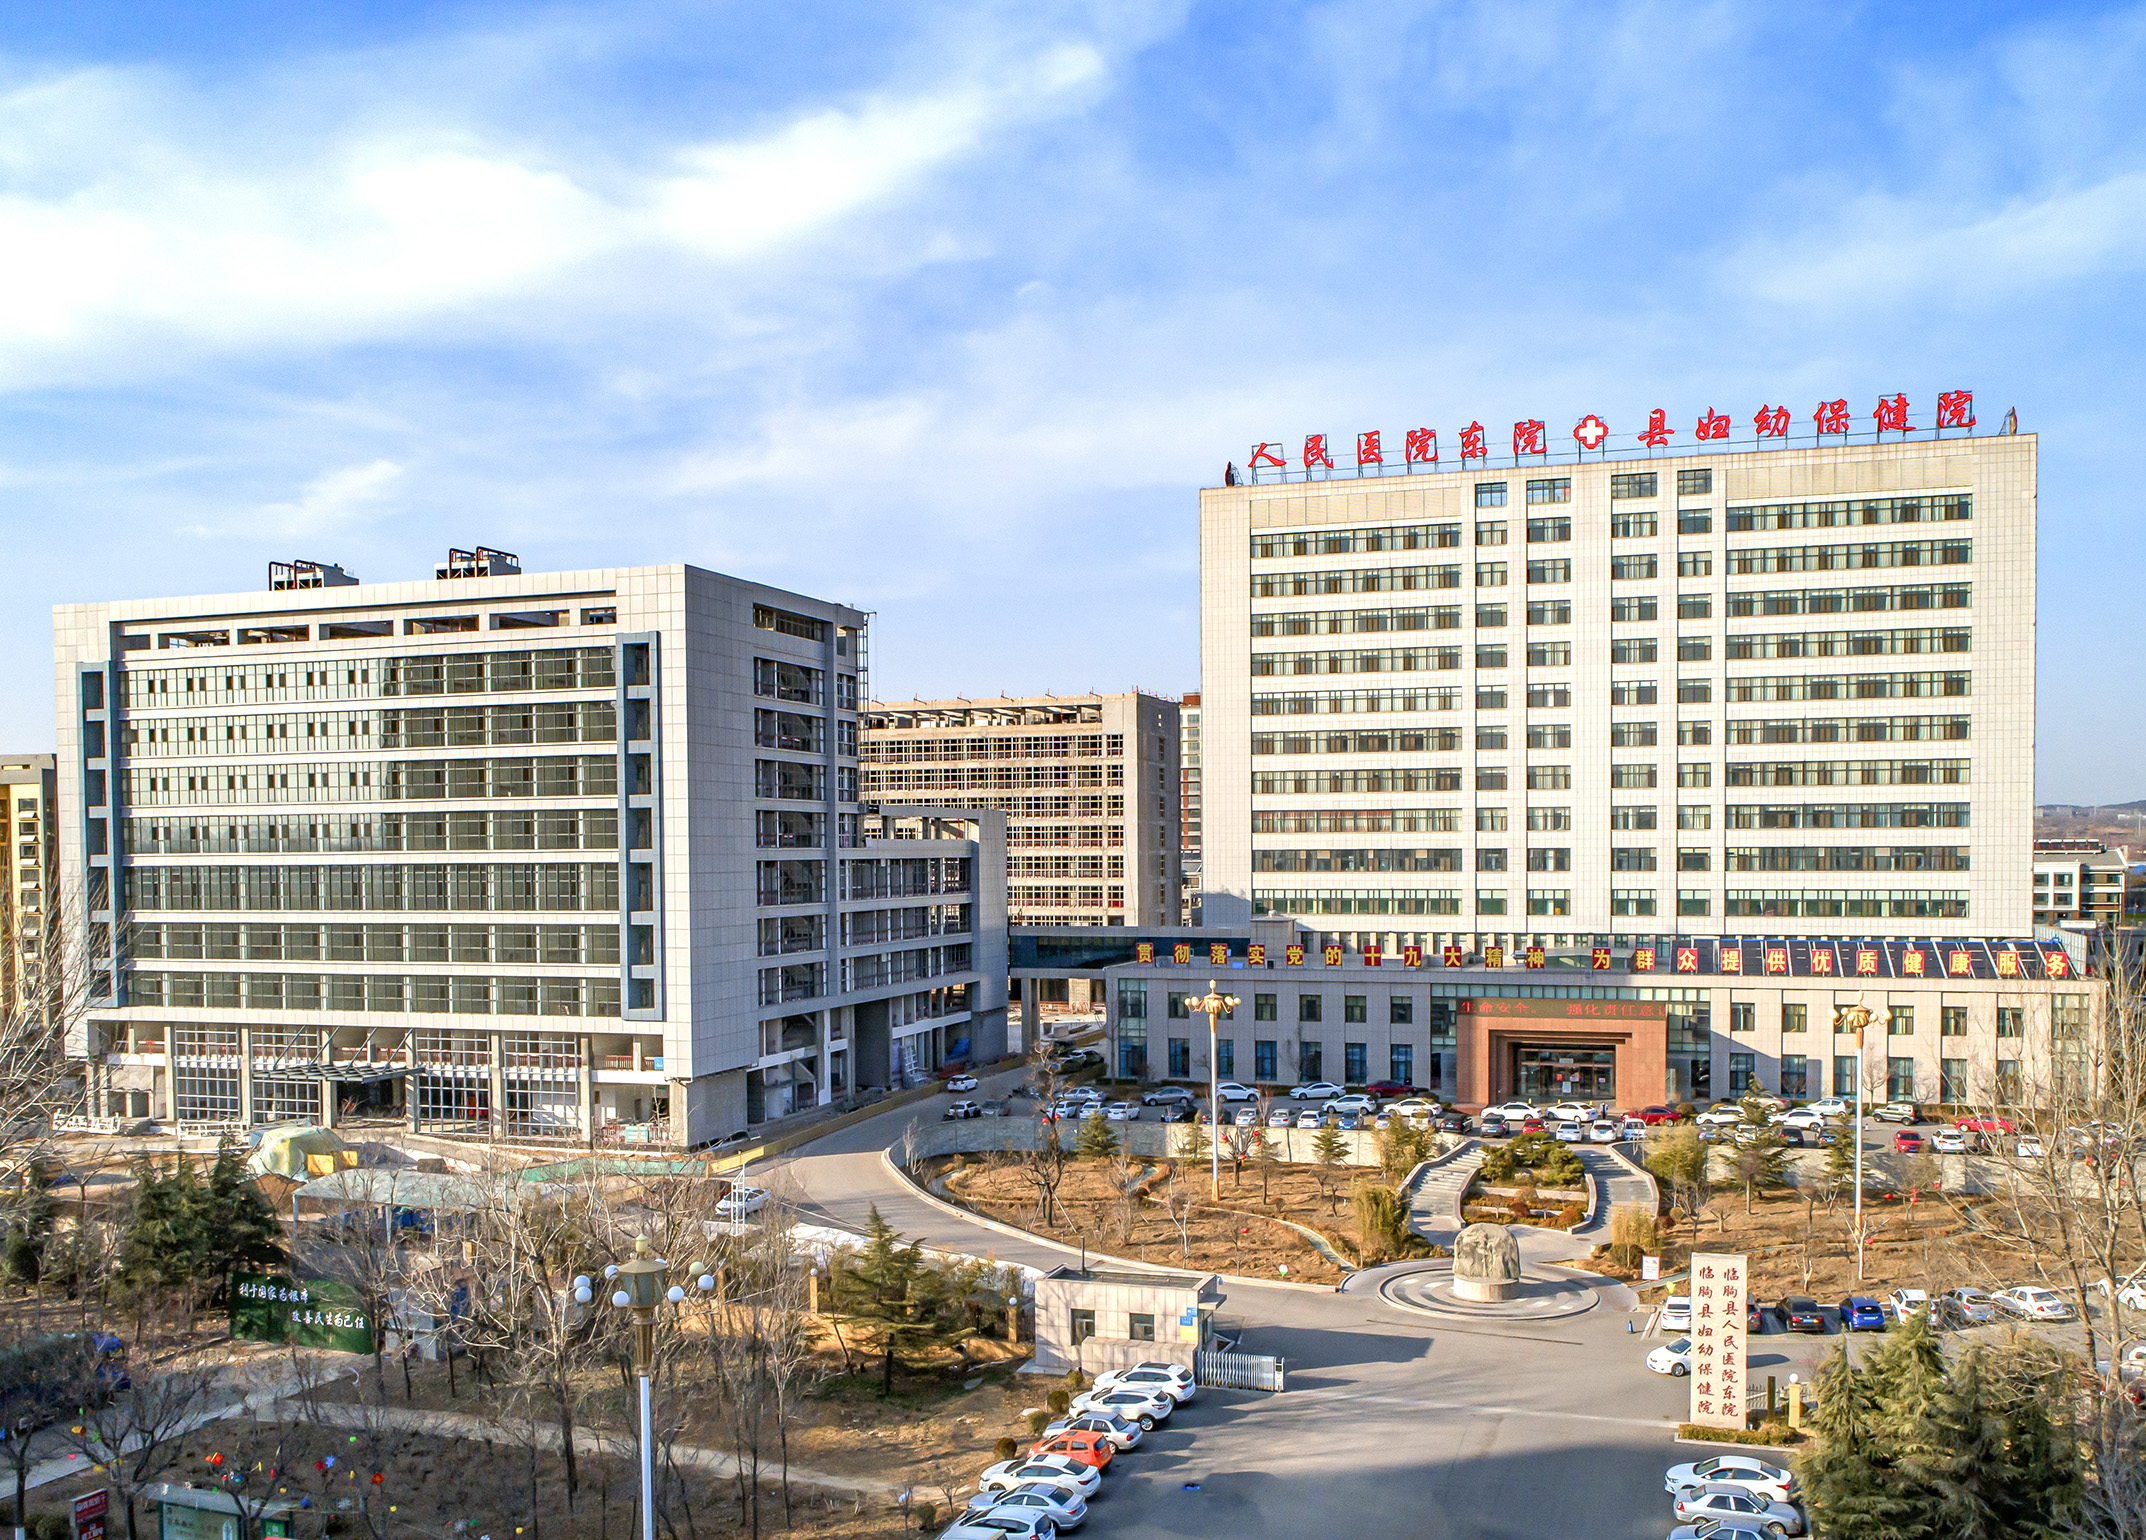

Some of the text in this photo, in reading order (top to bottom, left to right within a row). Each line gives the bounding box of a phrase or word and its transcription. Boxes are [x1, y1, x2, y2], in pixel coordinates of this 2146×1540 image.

[1248, 390, 1976, 469] 人民医院东院 县妇幼保健院
[1137, 943, 2067, 976] 贯彻落实党的十九大精神 为群众提供优质健康服务
[1697, 1266, 1715, 1415] 临朐县妇幼保健院
[1721, 1268, 1740, 1417] 临朐县人民医院东院
